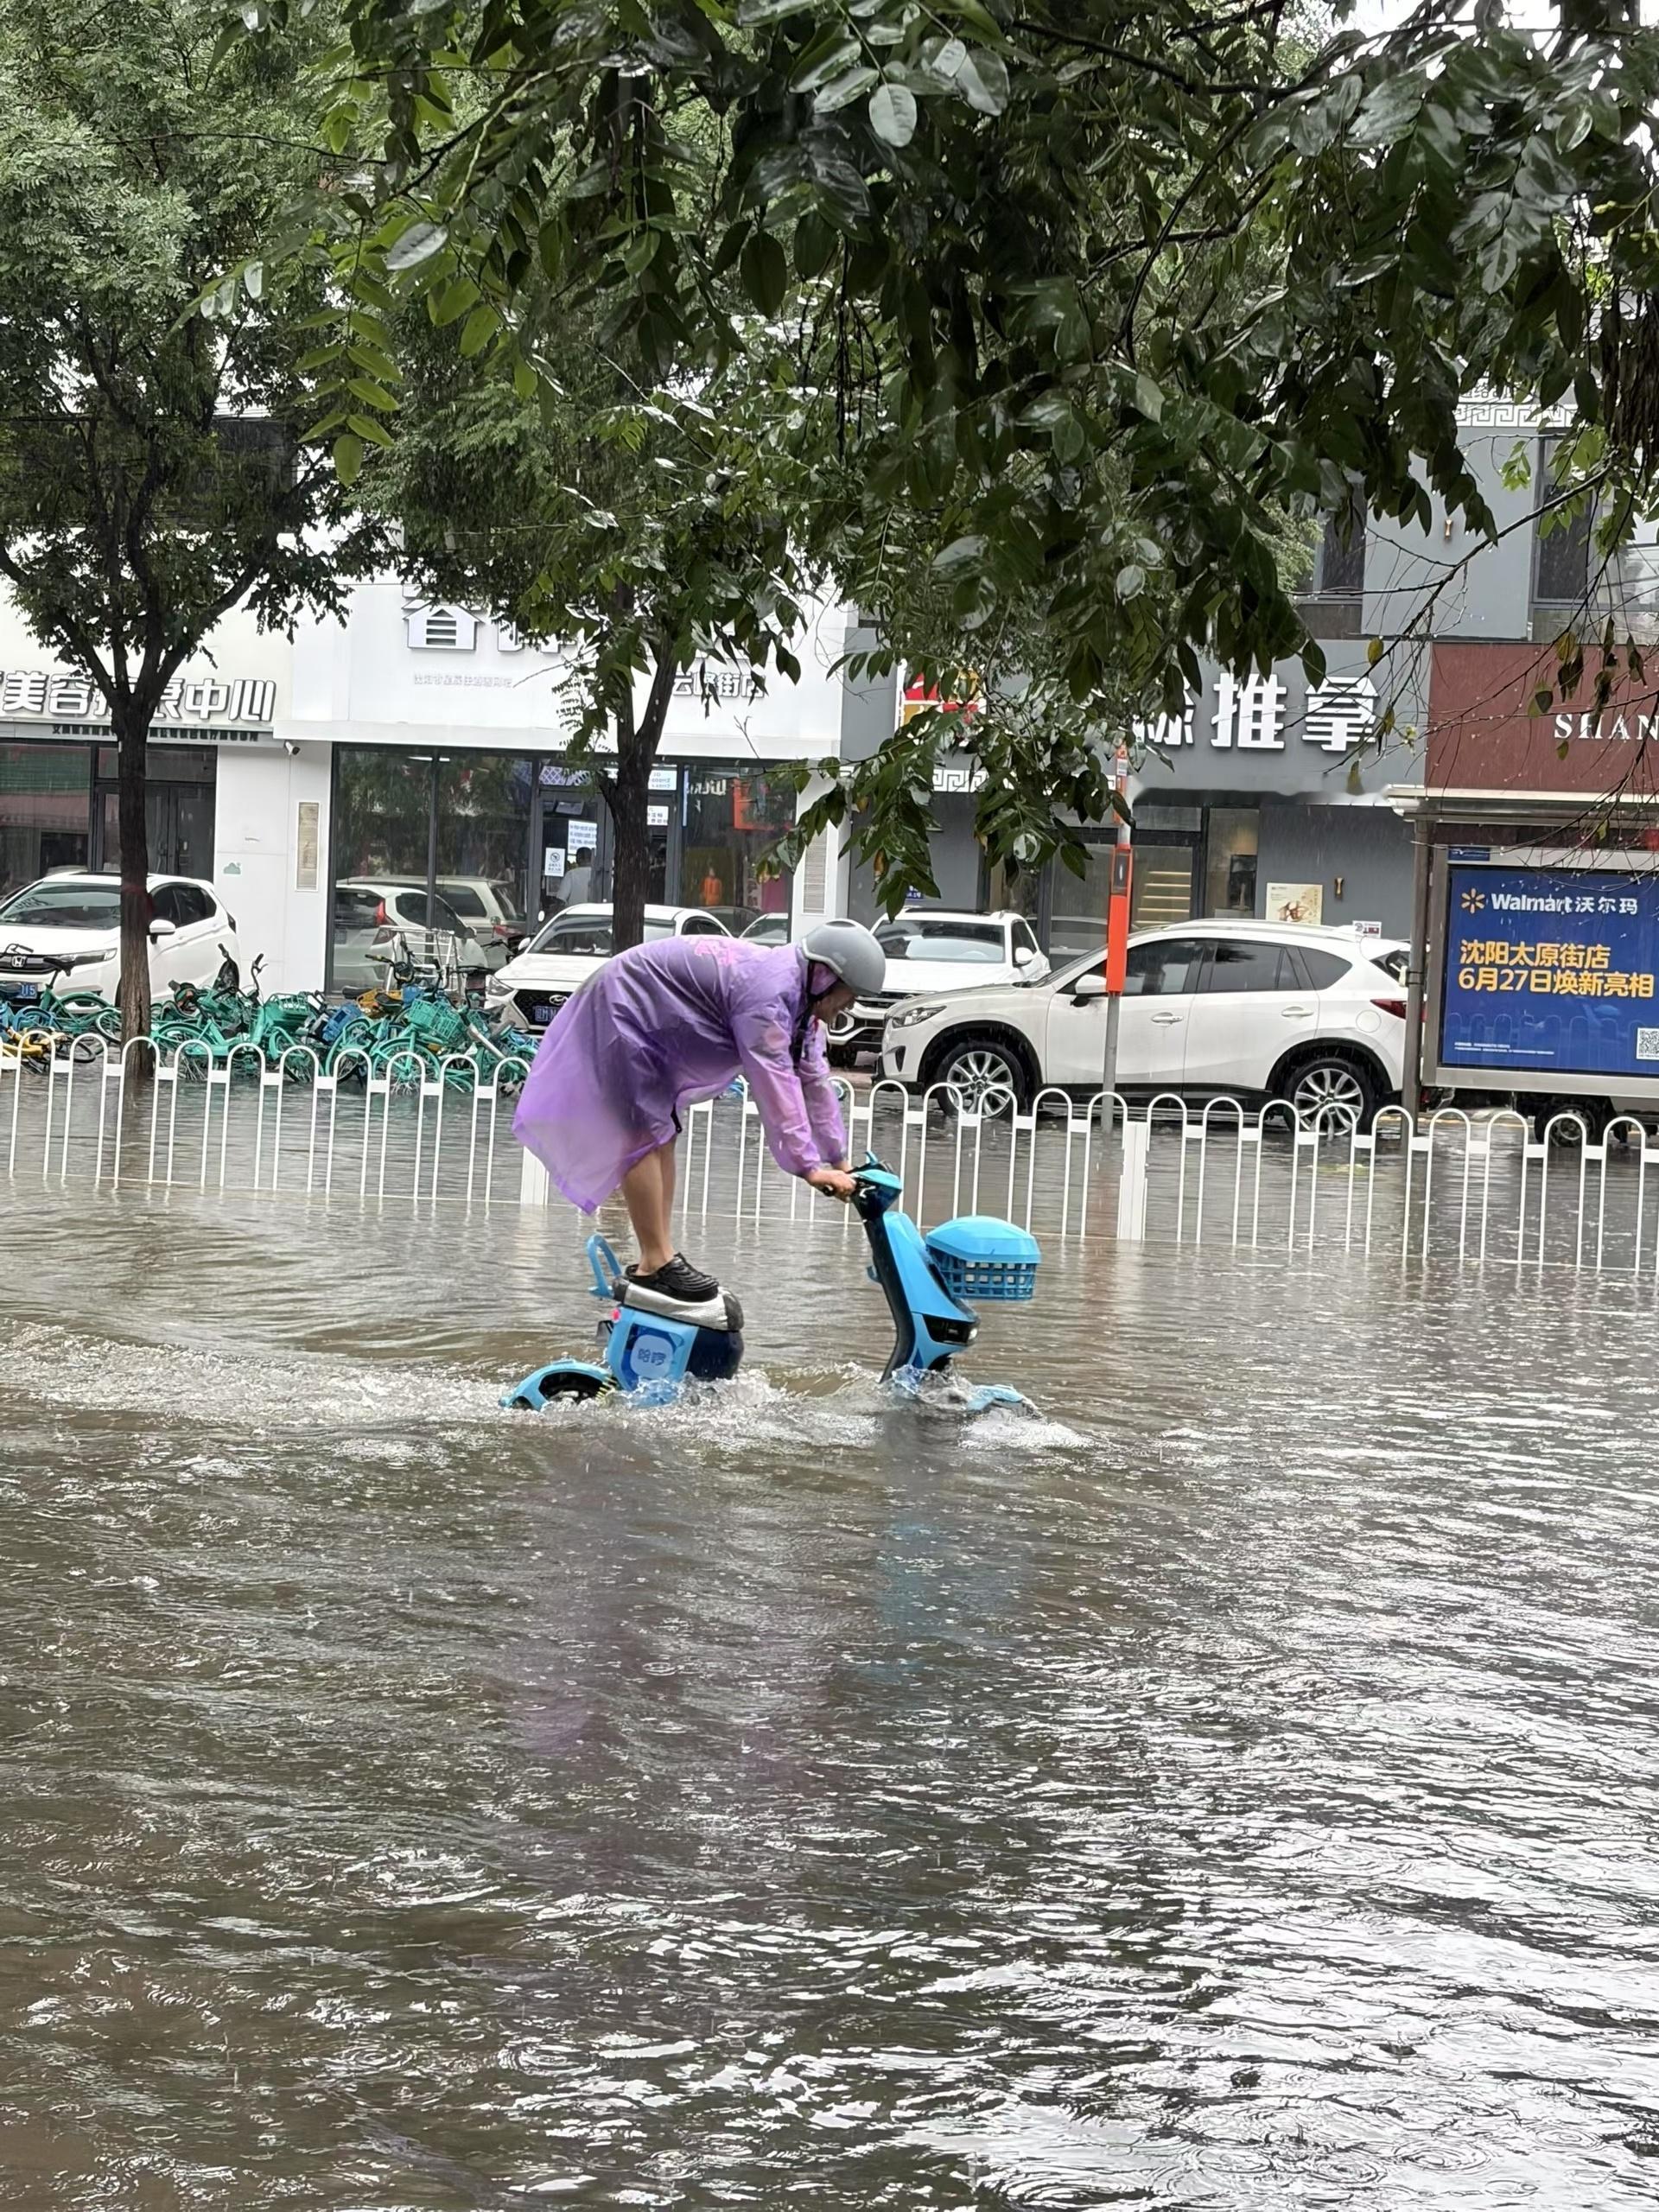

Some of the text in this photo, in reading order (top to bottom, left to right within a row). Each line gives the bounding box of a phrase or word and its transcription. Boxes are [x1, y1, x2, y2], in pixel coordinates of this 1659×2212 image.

[1491, 893, 1638, 916] Walmart 沃尔玛
[1460, 938, 1611, 969] 沈阳太原街店
[1458, 967, 1655, 998] 6月27日焕新亮相
